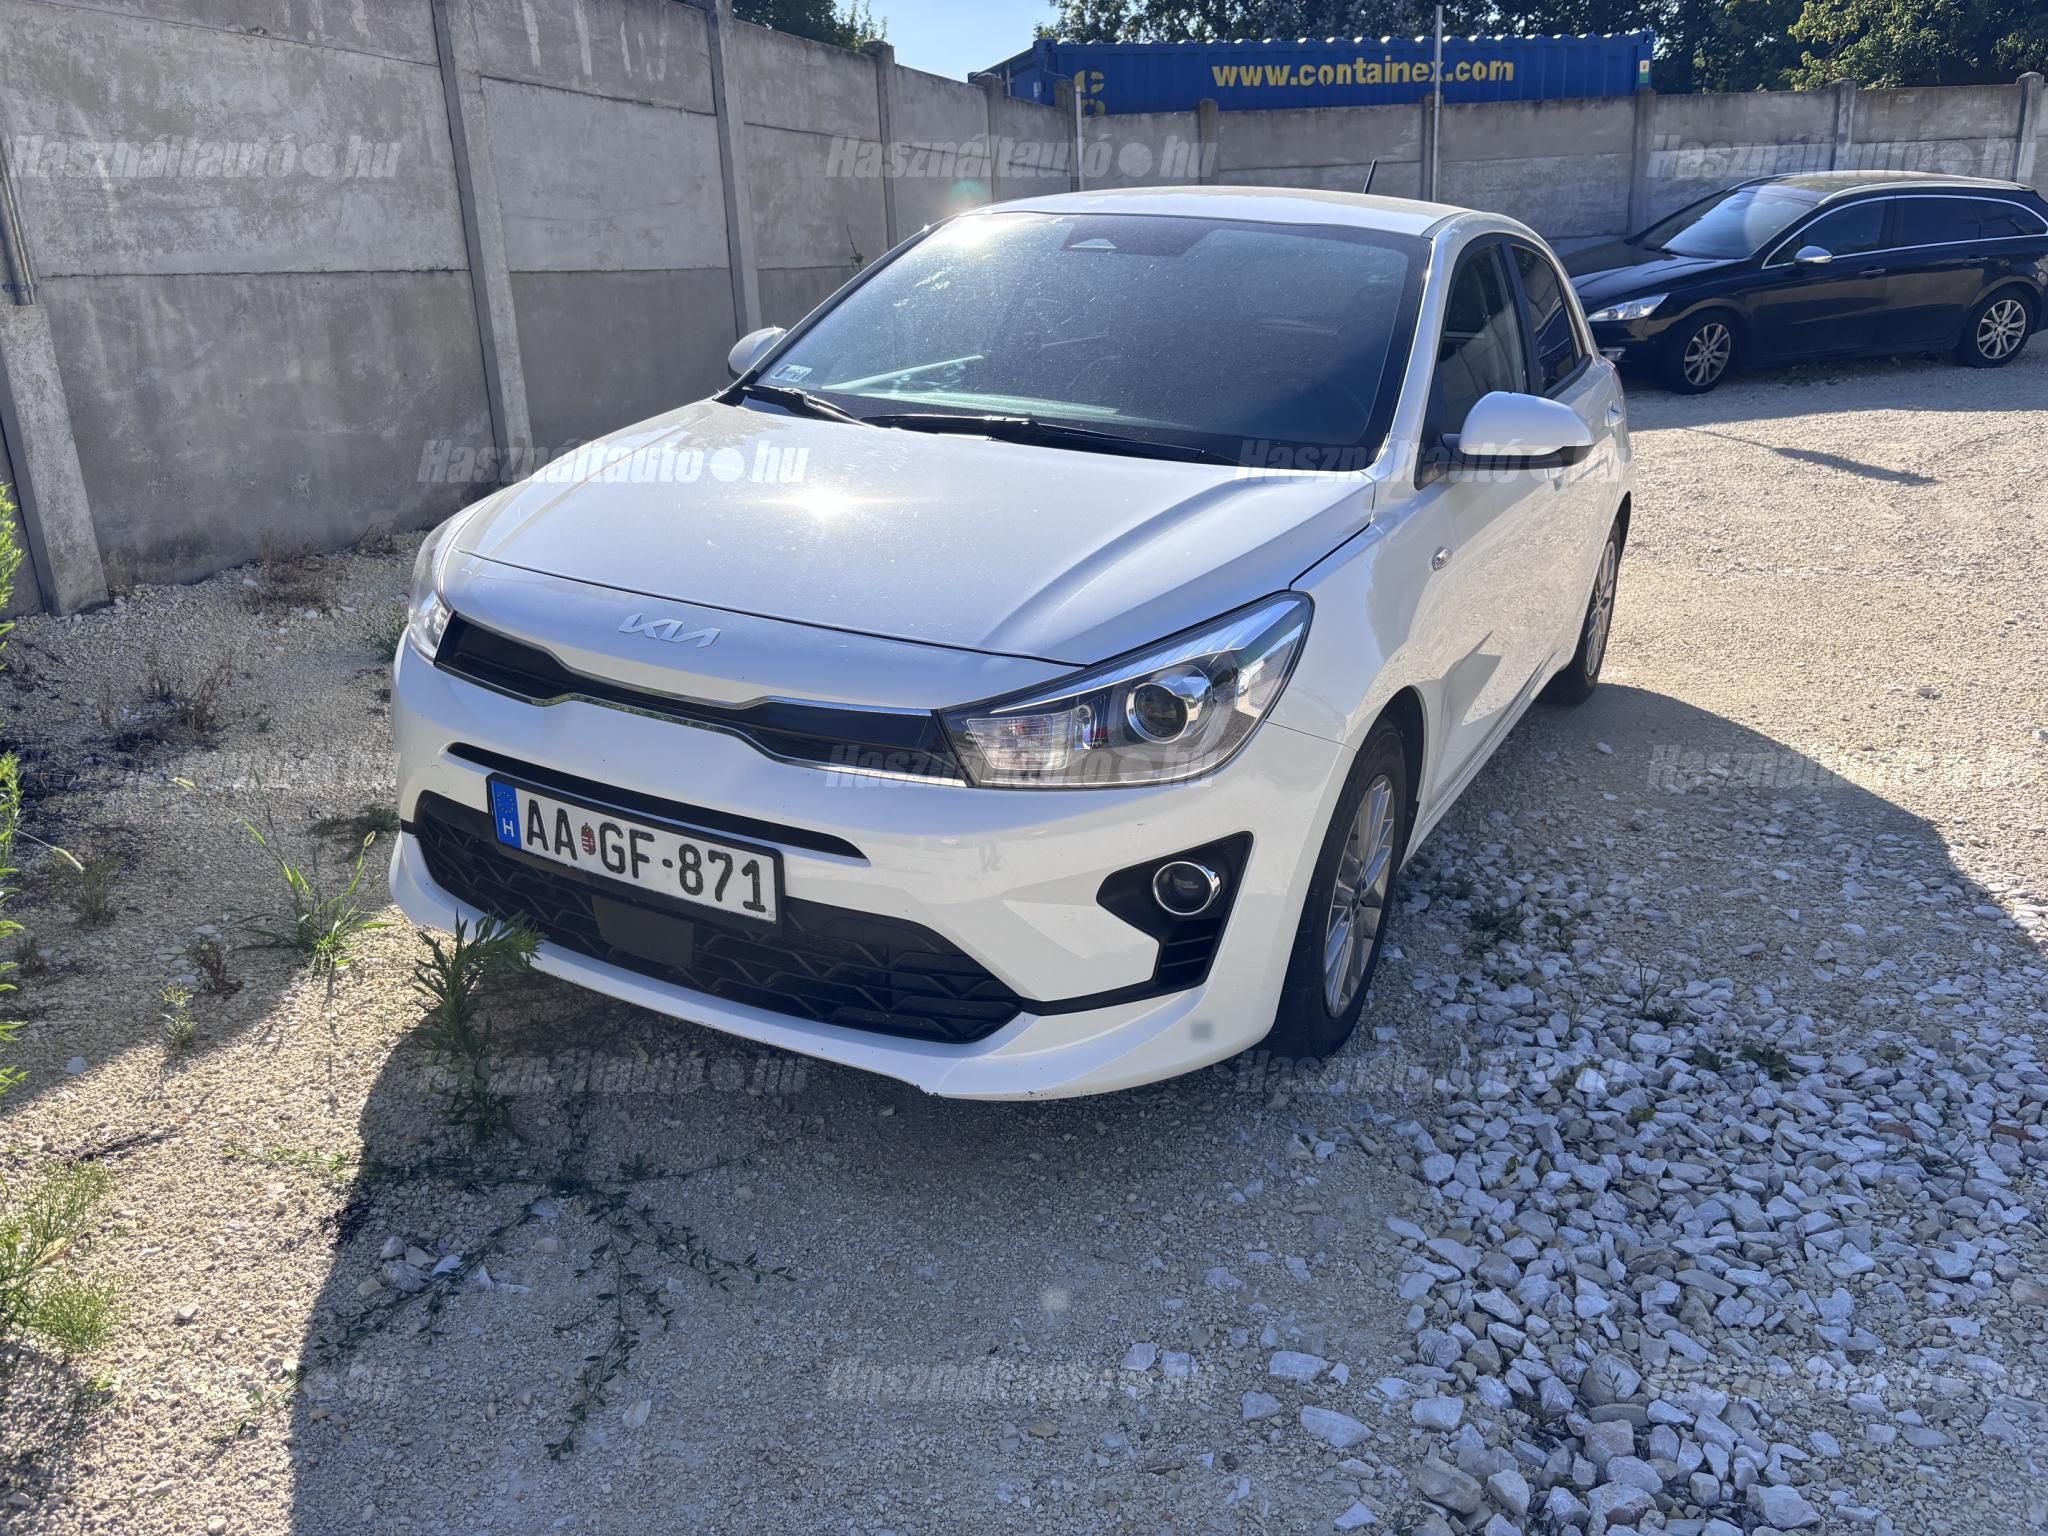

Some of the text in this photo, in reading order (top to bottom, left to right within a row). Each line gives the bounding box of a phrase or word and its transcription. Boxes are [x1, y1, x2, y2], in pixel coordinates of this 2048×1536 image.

[1212, 55, 1514, 87] www.containex.com
[618, 612, 721, 648] KIA
[502, 817, 515, 838] H
